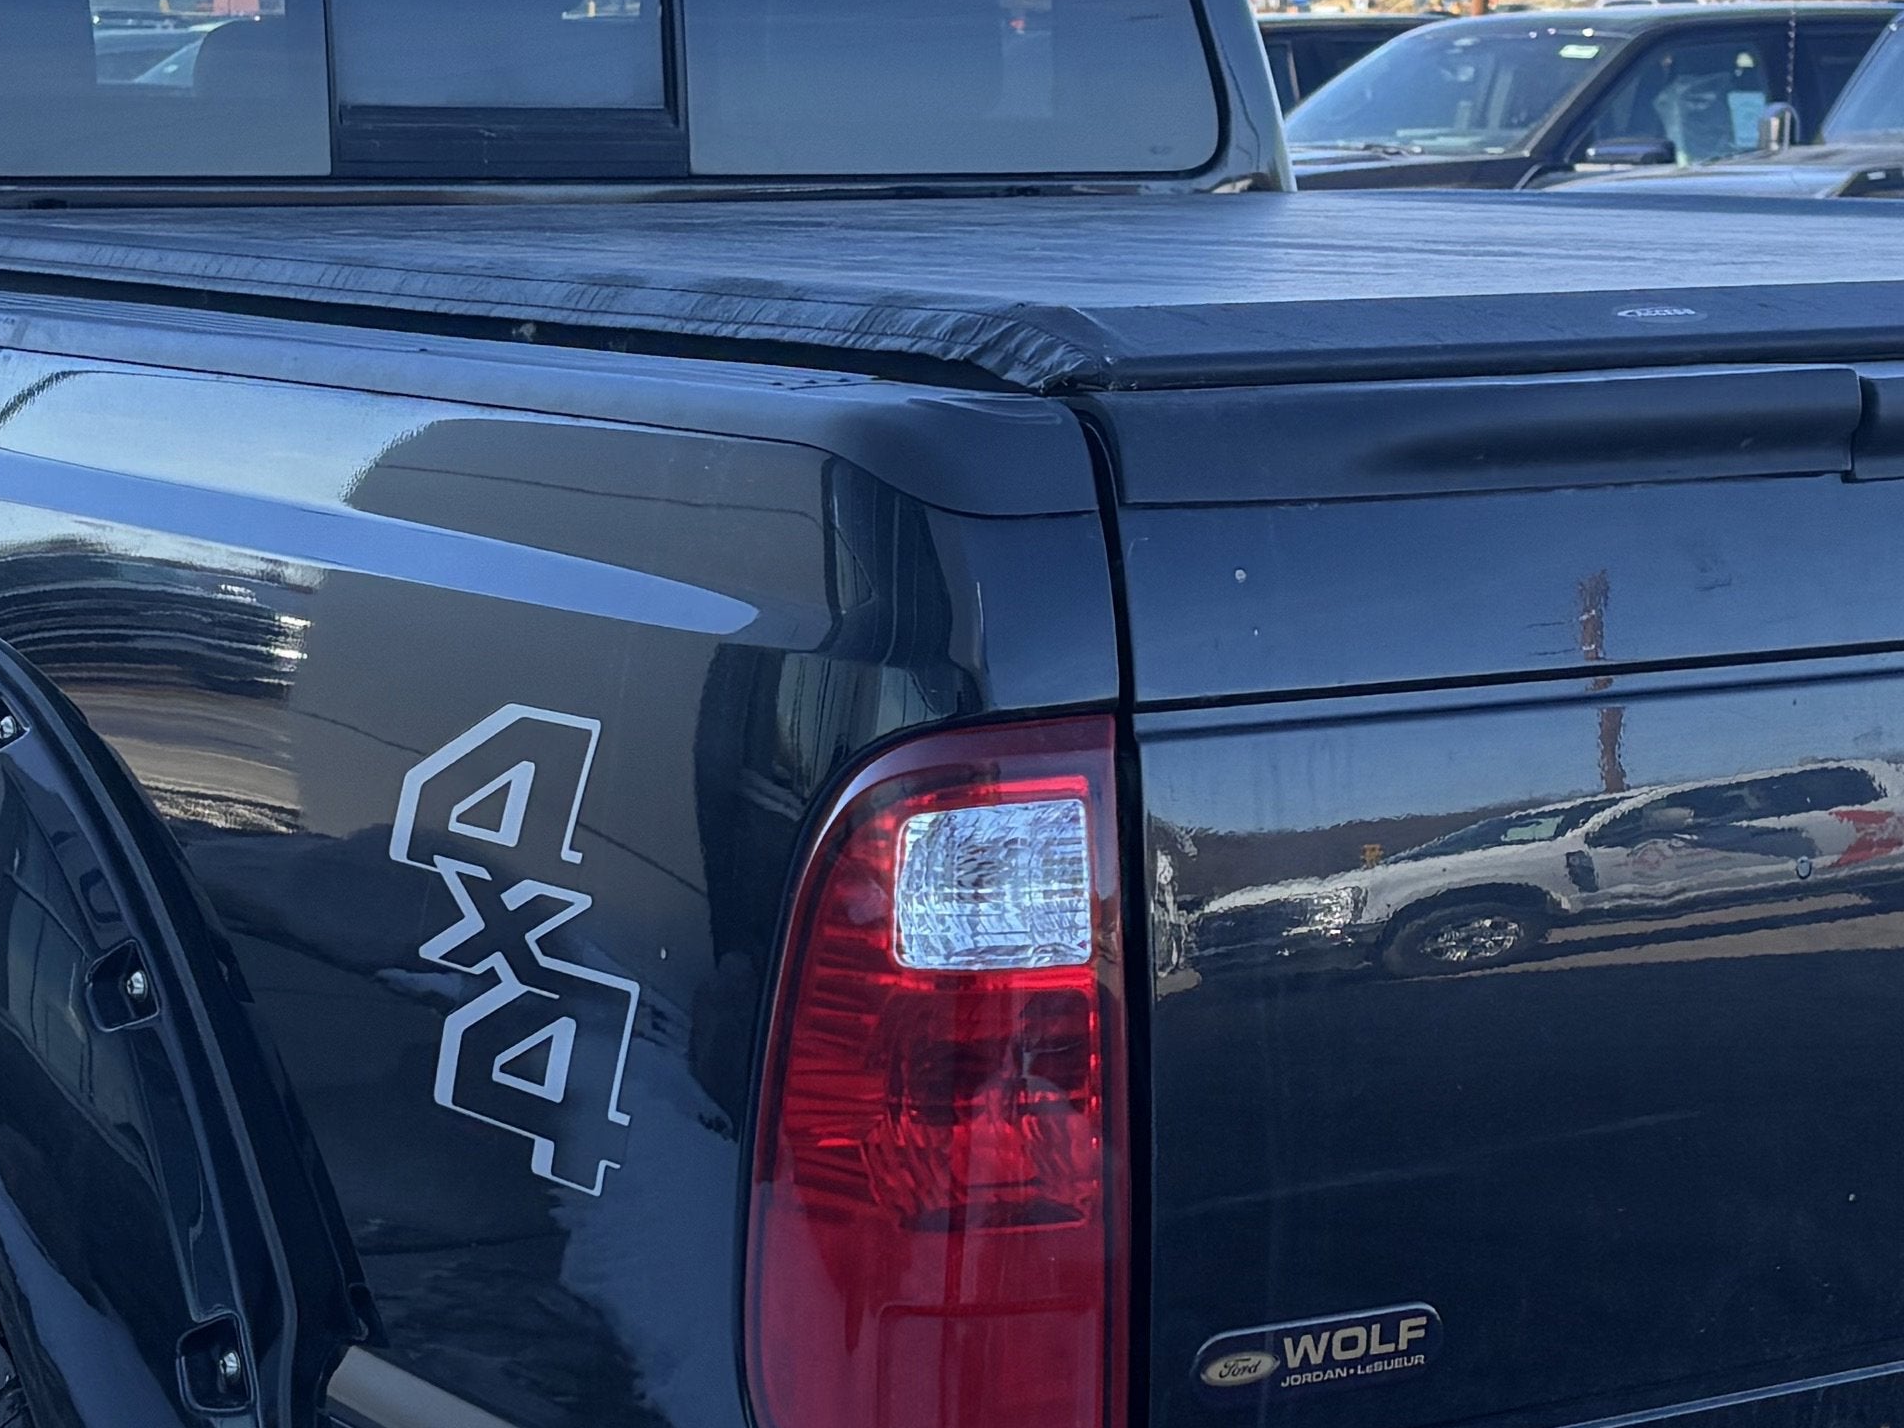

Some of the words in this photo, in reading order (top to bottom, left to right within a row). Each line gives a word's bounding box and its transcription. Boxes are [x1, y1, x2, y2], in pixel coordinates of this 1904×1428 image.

[1218, 1358, 1261, 1379] Ford
[1283, 1316, 1428, 1369] WOLF
[1281, 1368, 1347, 1387] JORDAN
